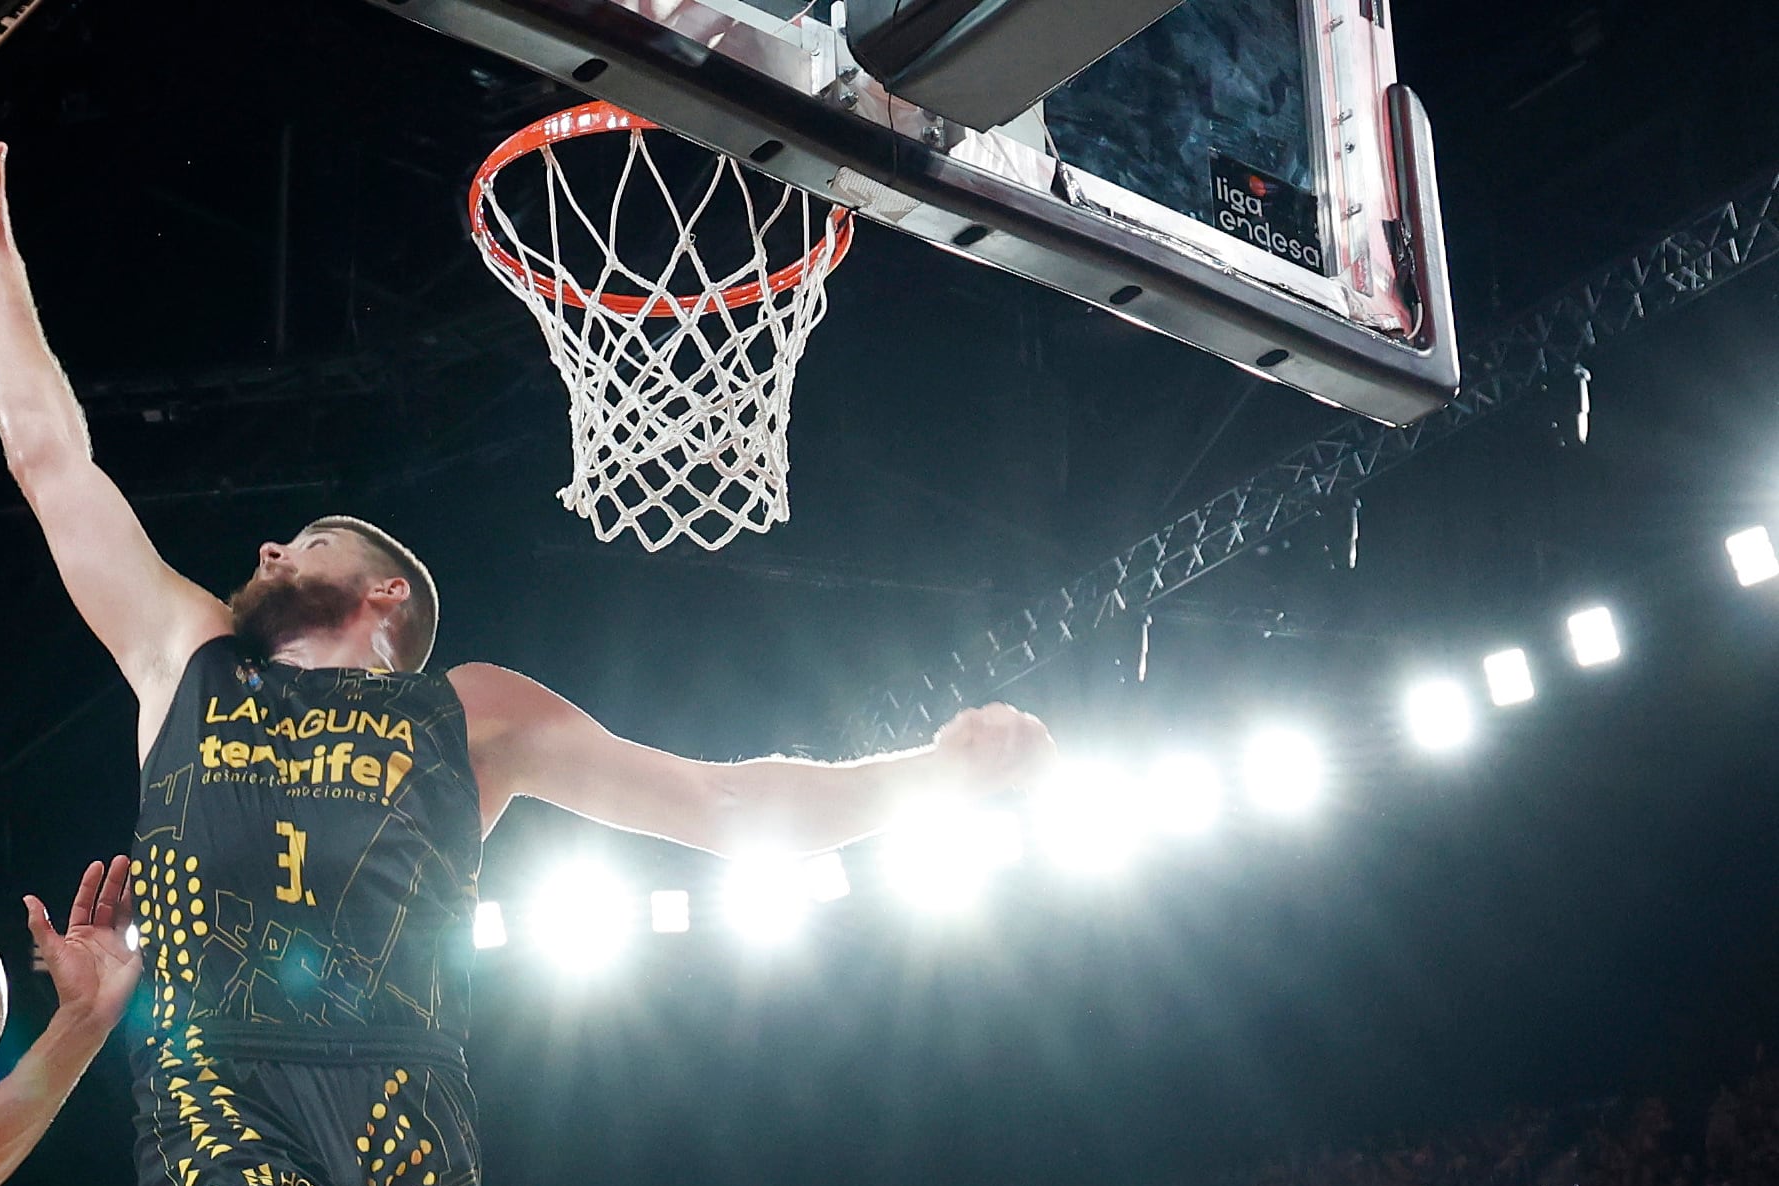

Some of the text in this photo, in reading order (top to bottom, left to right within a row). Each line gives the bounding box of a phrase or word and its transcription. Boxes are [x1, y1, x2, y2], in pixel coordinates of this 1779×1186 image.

[1216, 176, 1263, 217] liga
[1220, 211, 1321, 268] endesa
[206, 696, 260, 724] LA
